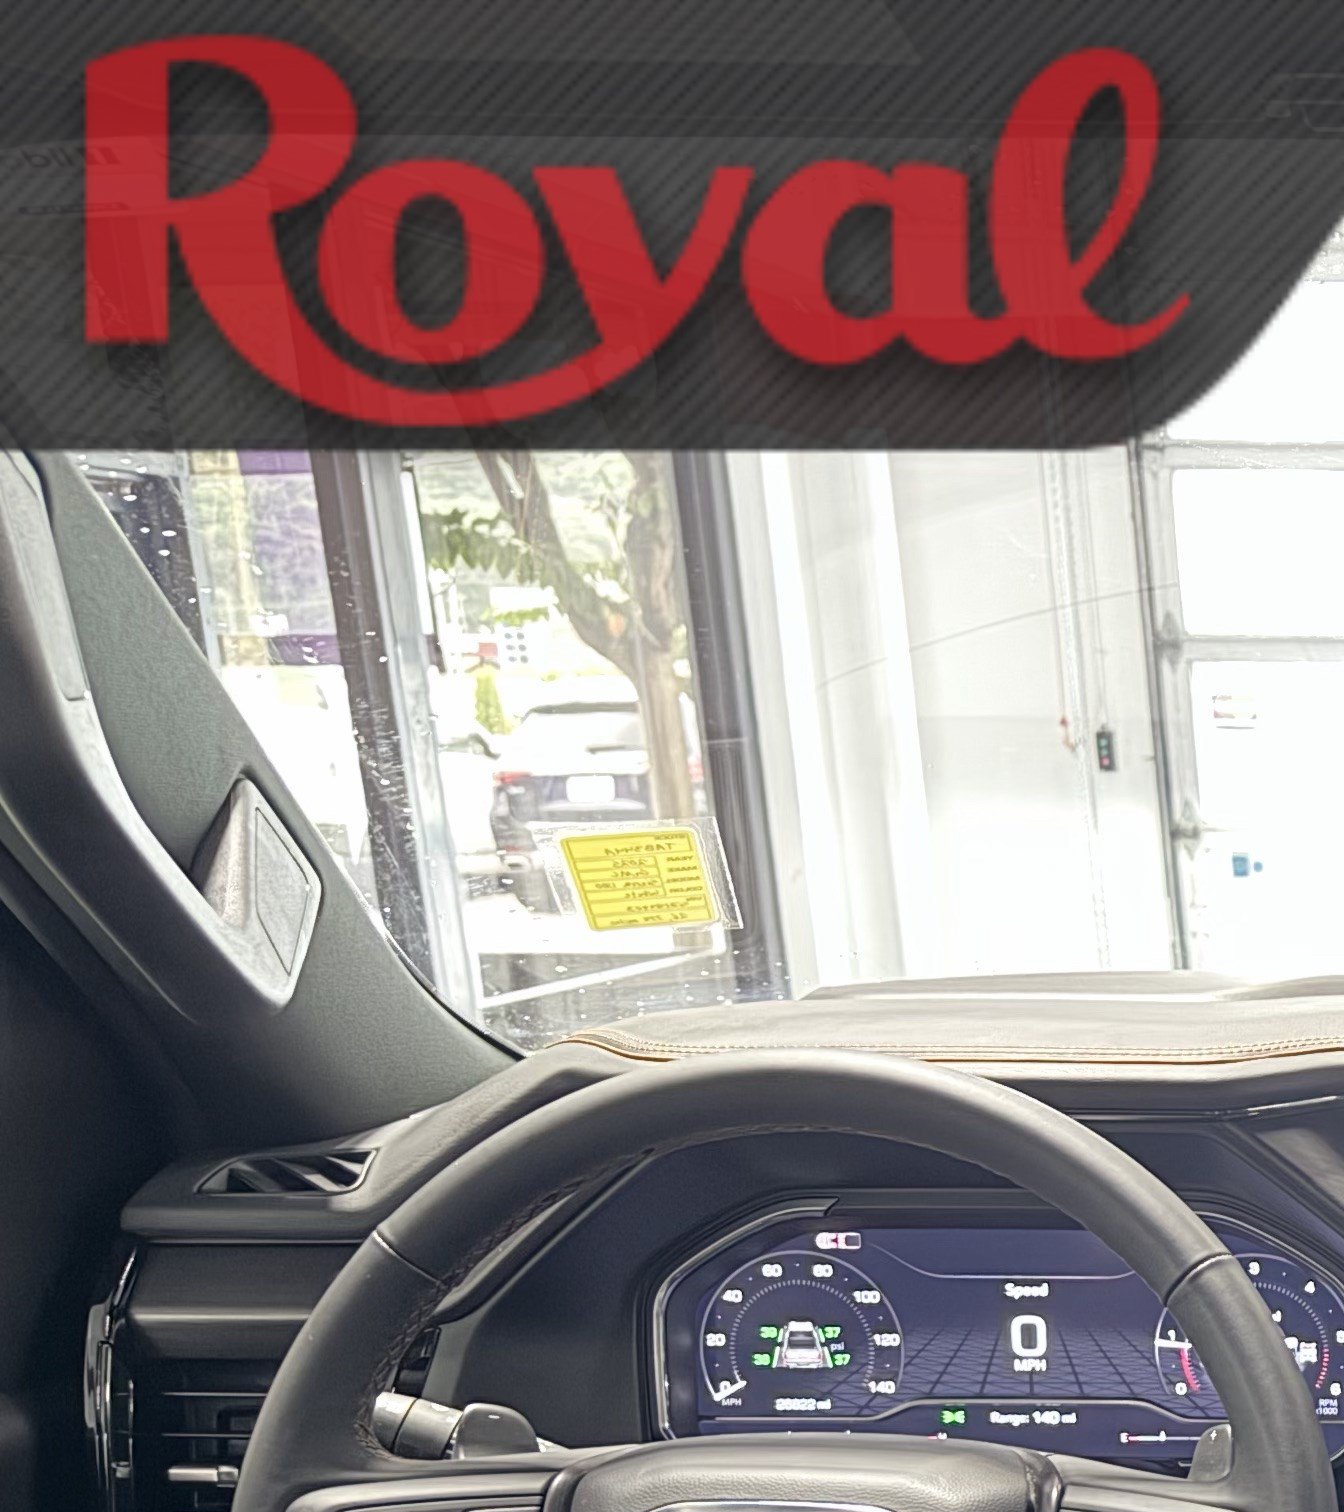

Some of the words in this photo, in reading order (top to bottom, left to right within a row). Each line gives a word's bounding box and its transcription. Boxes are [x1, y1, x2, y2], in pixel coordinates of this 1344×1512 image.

[721, 1288, 744, 1303] 40
[852, 1290, 881, 1304] 100
[1004, 1282, 1050, 1300] Speed
[706, 1332, 726, 1347] 20
[873, 1332, 901, 1347] 120
[1010, 1314, 1048, 1358] 0
[1013, 1359, 1047, 1372] MPH
[868, 1380, 896, 1394] 140
[721, 1397, 742, 1407] MPH
[1318, 1398, 1338, 1407] RPM
[989, 1410, 1031, 1427] Range:
[1031, 1410, 1062, 1425] 140
